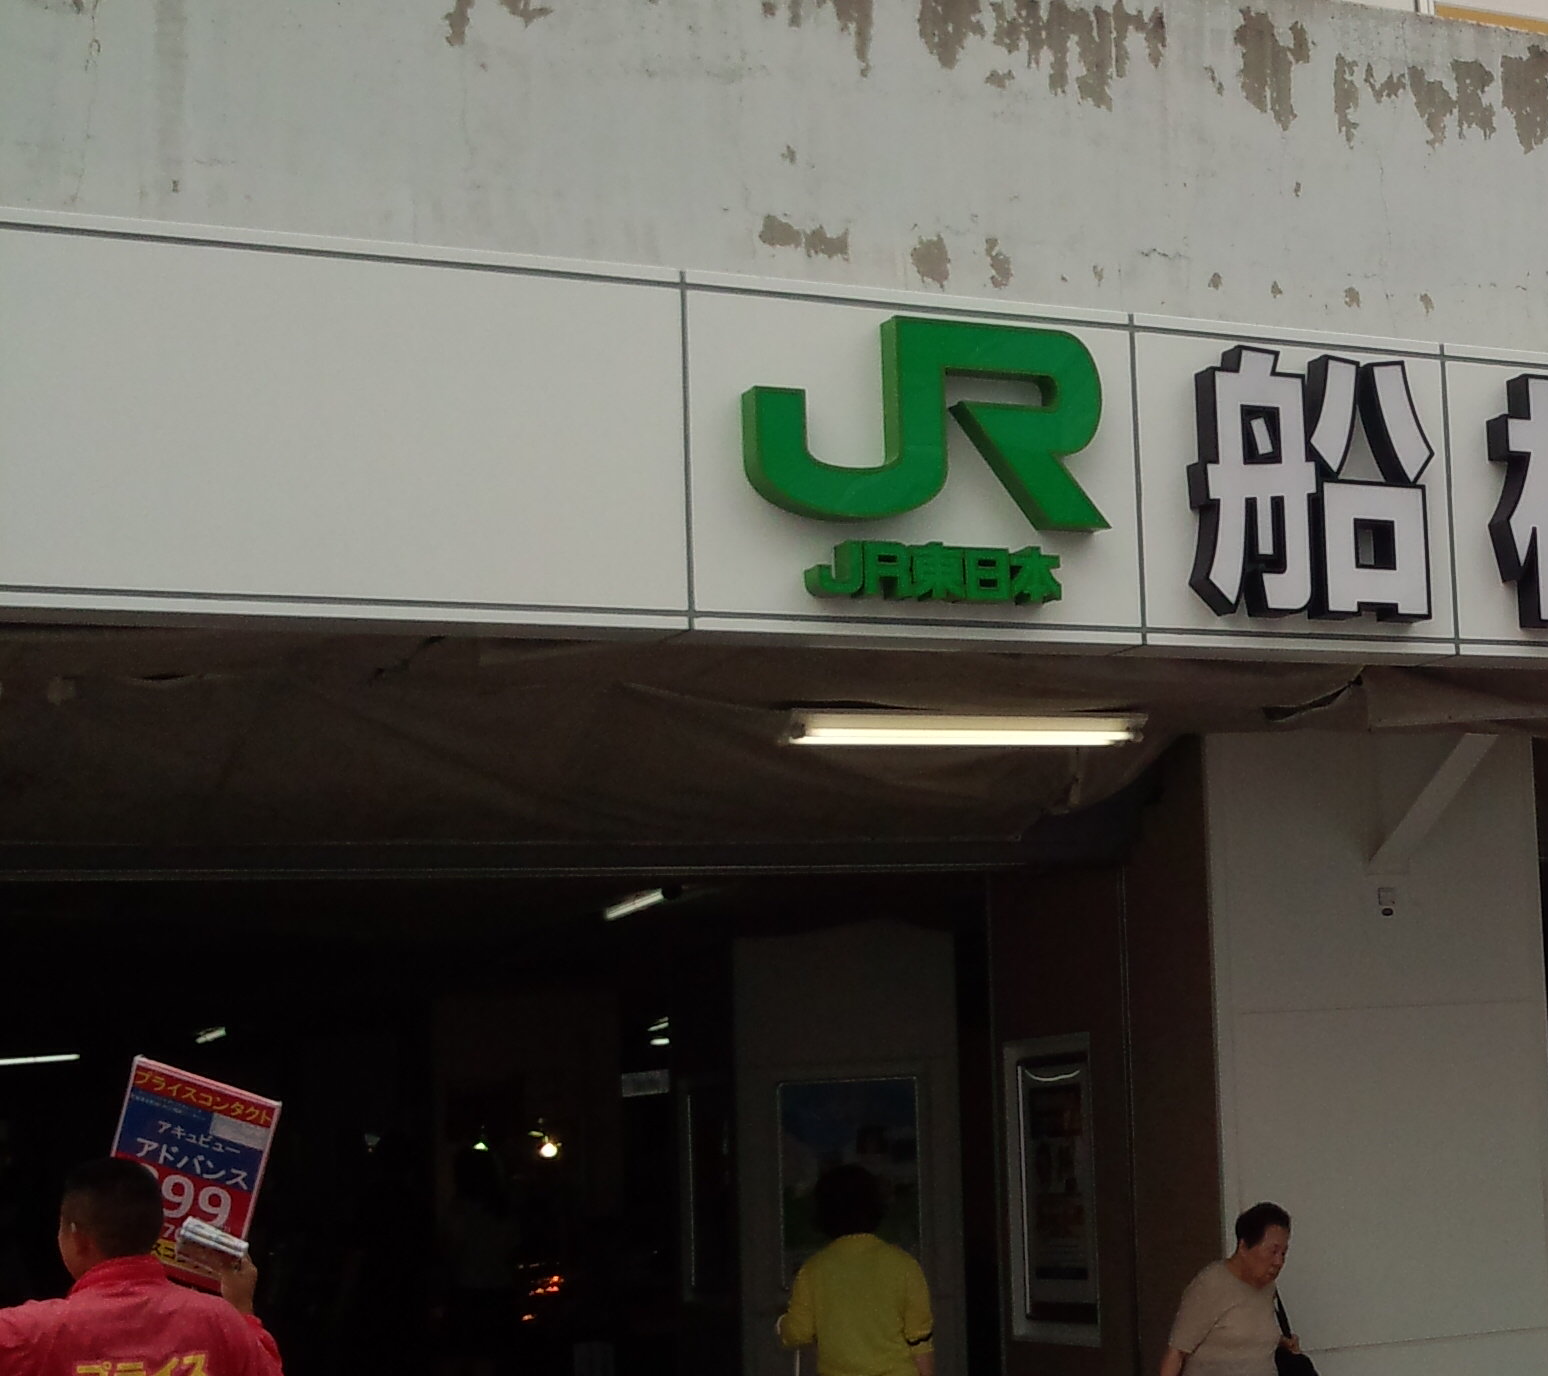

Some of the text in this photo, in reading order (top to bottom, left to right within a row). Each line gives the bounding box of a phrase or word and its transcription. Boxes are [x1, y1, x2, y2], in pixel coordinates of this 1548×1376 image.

[741, 315, 1112, 532] JR
[804, 540, 1062, 606] JR東日本
[133, 1071, 273, 1124] プライスコンタクト
[136, 1137, 248, 1191] アドバンス
[157, 1120, 241, 1154] アキュビュー
[140, 1162, 232, 1228] 99
